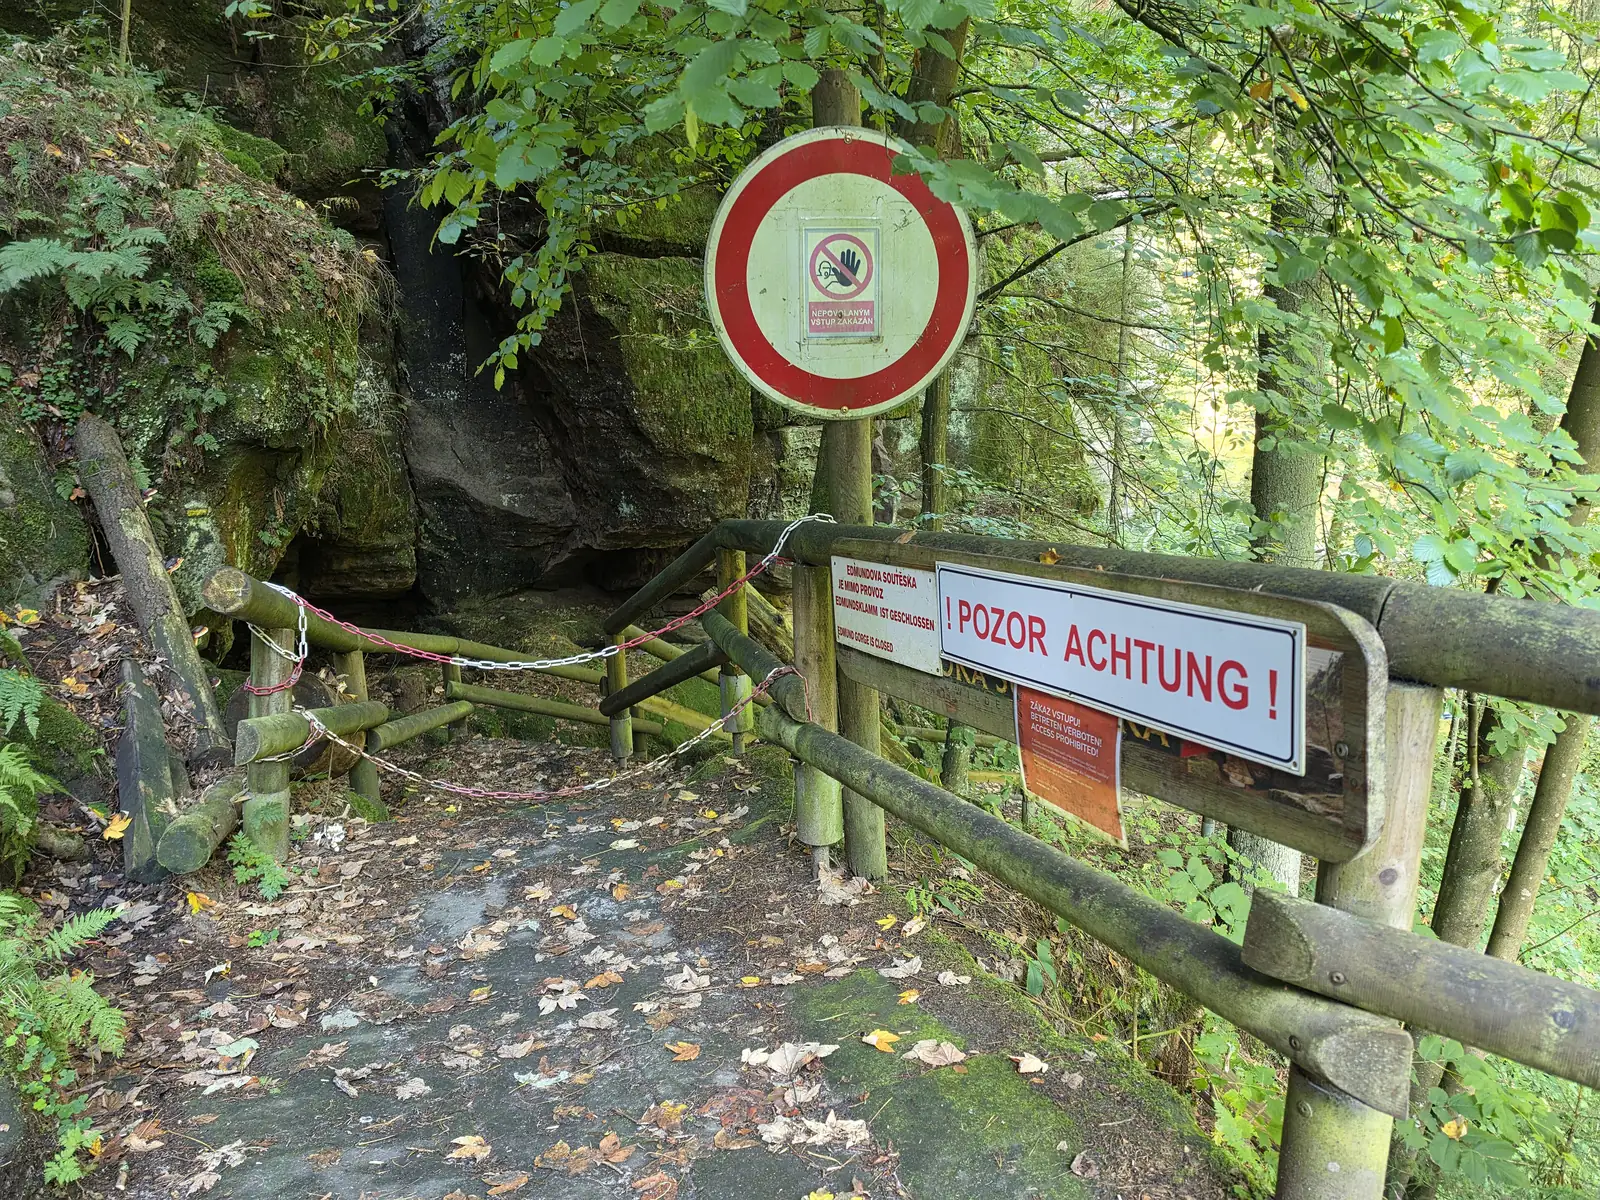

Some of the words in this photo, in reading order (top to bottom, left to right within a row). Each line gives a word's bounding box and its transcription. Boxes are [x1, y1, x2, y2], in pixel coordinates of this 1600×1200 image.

[811, 318, 836, 326] VSTUP
[838, 579, 844, 590] JE
[844, 580, 859, 594] MIMO
[860, 584, 884, 599] PROVOZ
[846, 564, 882, 582] EDMUNDOVA
[882, 570, 917, 589] SOUTĚSKA
[835, 595, 878, 616] EDMUNDSKLAMM
[879, 606, 889, 619] IST
[889, 609, 935, 631] GESCHLOSSEN
[837, 626, 855, 640] EDMUND
[855, 630, 870, 644] GORGE
[870, 635, 875, 647] IS
[875, 637, 893, 653] CLOSED
[958, 599, 1048, 657] POZOR
[1064, 624, 1249, 710] ACHTUNG
[1030, 701, 1051, 716] ZÁKAZ
[1051, 709, 1081, 728] VSTUPU!
[1030, 712, 1062, 731] BETRETEN
[1063, 725, 1102, 748] VERBOTEN!
[1031, 723, 1055, 739] ACCESS
[1055, 733, 1099, 758] PROHIBITED!
